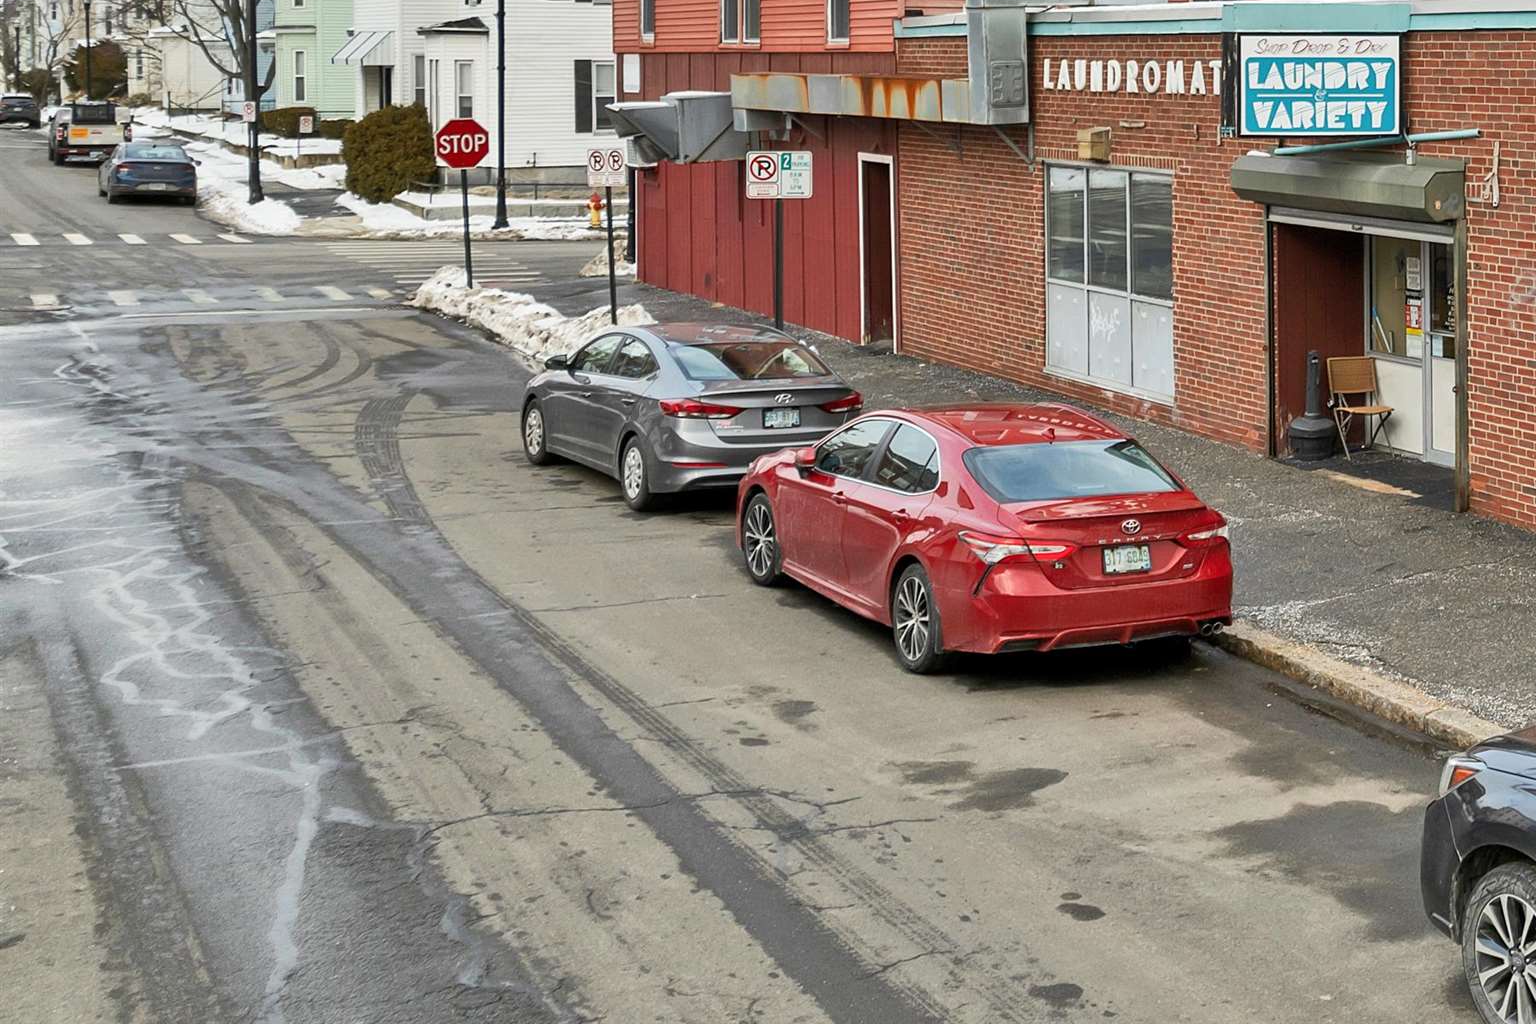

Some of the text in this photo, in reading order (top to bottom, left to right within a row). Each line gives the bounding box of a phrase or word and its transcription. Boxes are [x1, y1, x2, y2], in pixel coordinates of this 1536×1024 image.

[1043, 58, 1222, 96] LAUNDROMAT
[1248, 61, 1393, 90] LAUNDRY
[1252, 101, 1388, 129] VARIETY
[439, 133, 487, 154] STOP
[783, 154, 790, 169] 2
